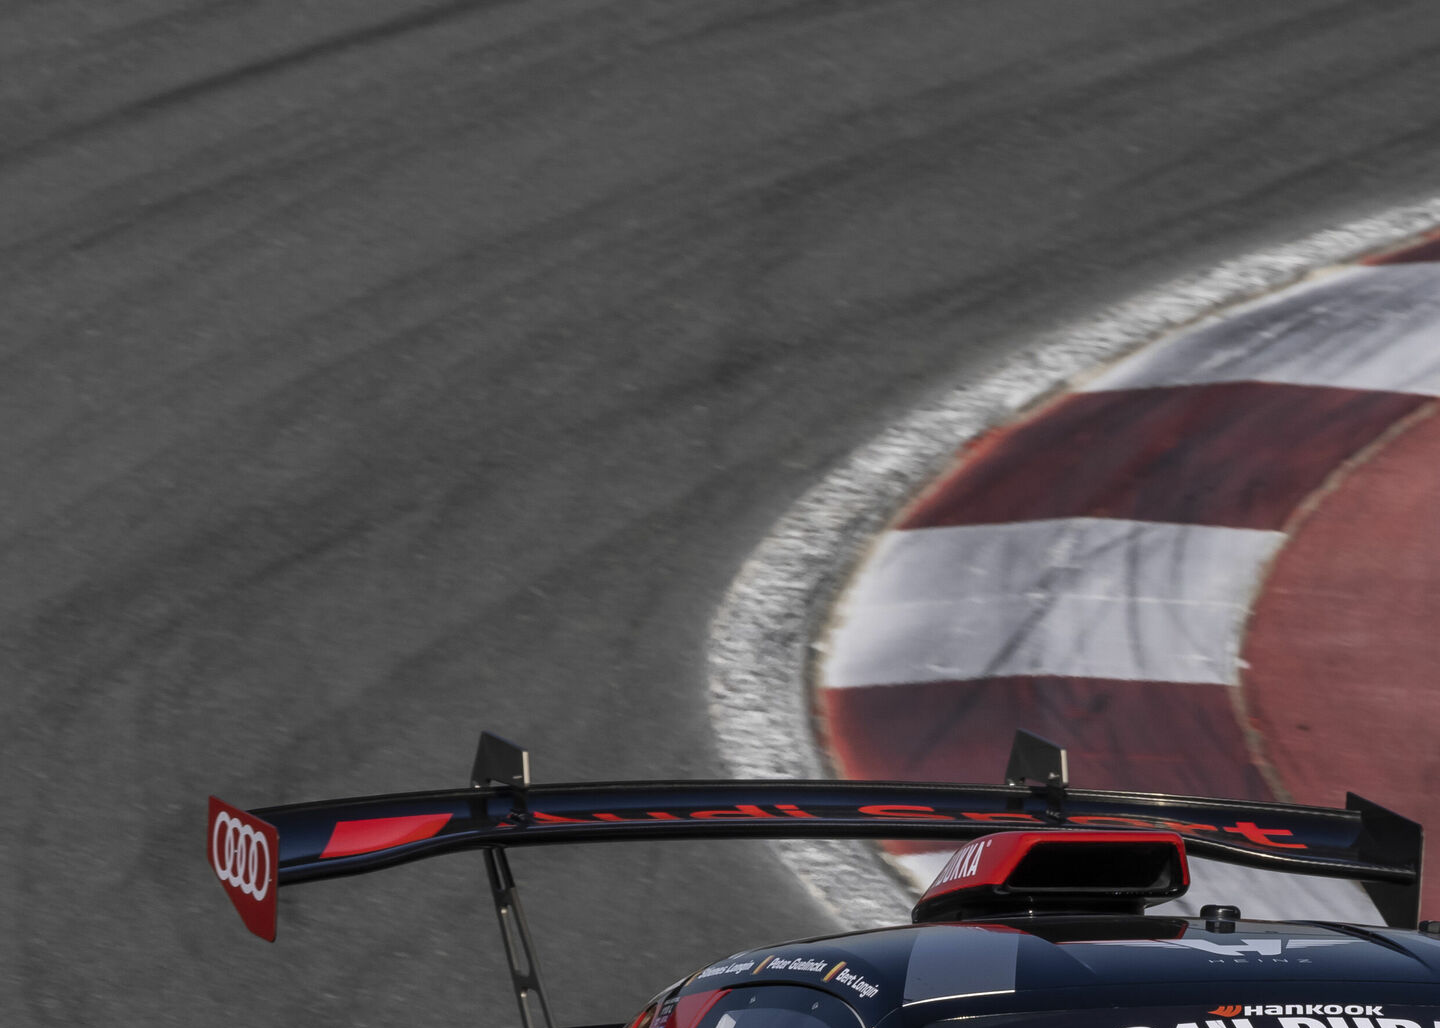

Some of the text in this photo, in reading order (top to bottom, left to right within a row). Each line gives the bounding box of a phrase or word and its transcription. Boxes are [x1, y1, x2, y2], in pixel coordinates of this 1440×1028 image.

[766, 957, 792, 970] Peter
[836, 968, 880, 998] Bert Longin
